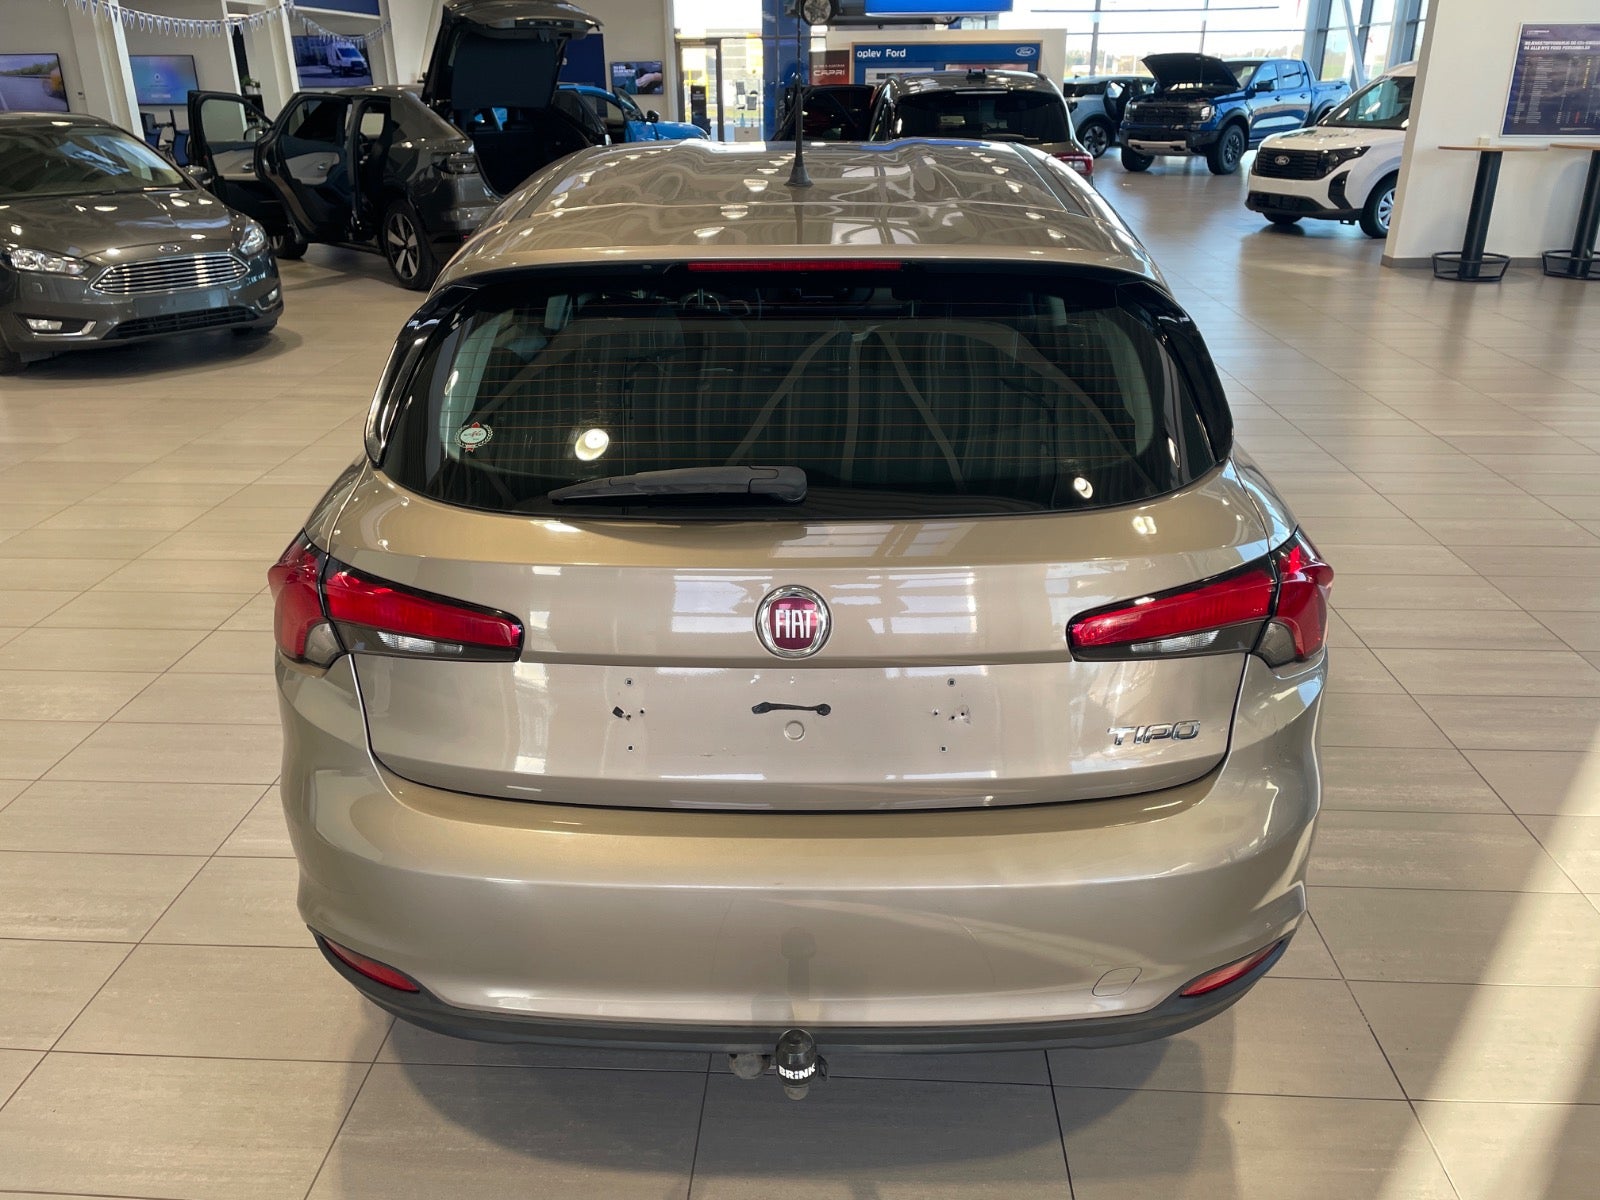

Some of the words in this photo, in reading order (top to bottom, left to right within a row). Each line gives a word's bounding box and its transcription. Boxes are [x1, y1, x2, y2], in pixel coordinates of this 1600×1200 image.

[857, 49, 881, 58] oplev
[886, 48, 907, 57] Ford
[775, 609, 813, 638] FIAT
[1107, 719, 1201, 745] TIPO
